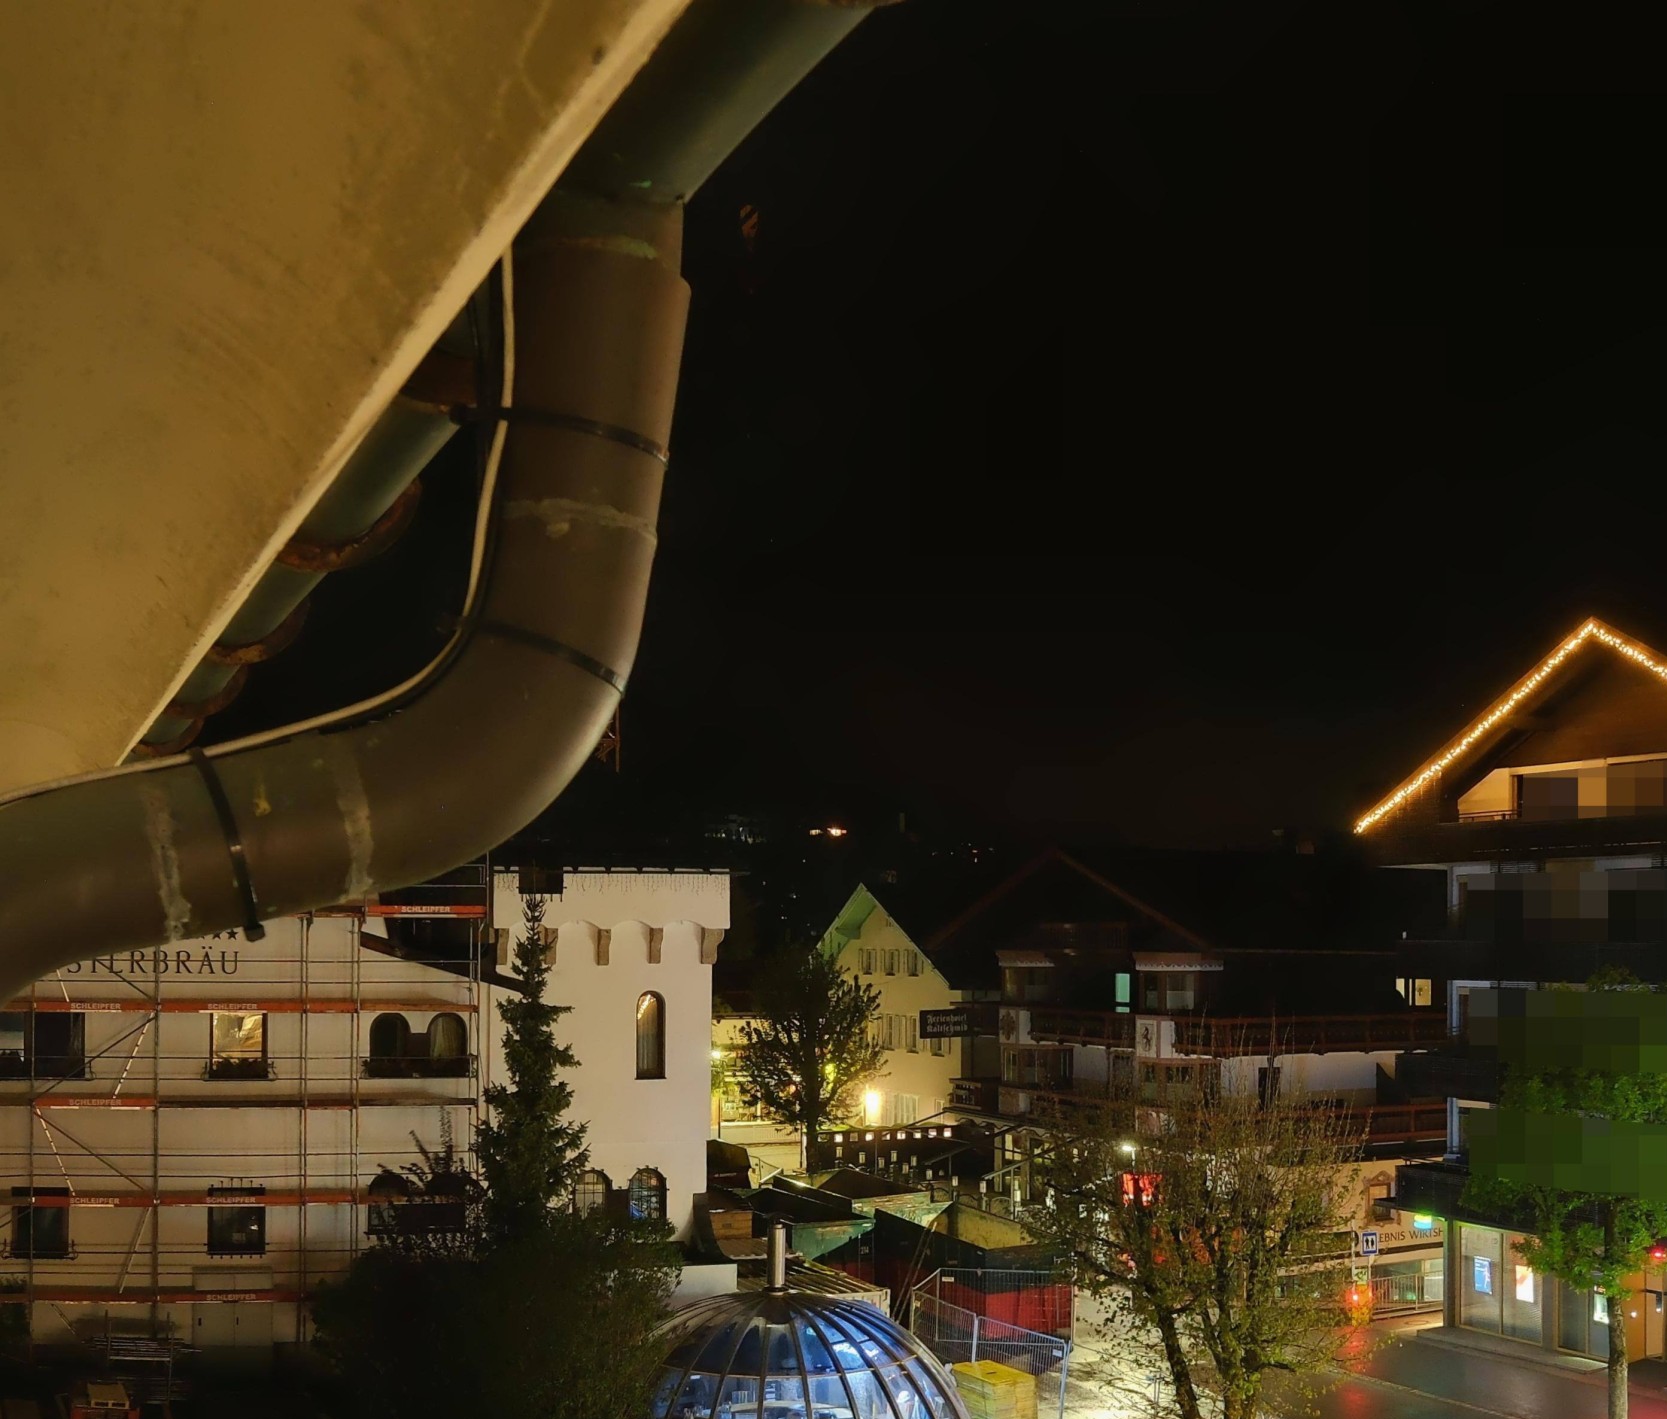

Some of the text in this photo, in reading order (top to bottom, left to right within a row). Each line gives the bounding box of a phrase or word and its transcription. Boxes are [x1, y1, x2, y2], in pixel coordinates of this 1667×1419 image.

[401, 905, 451, 913] SCHLEIPFER
[70, 1002, 121, 1010] SCHLEIPFER
[206, 1196, 256, 1204] SCHLEIPFER
